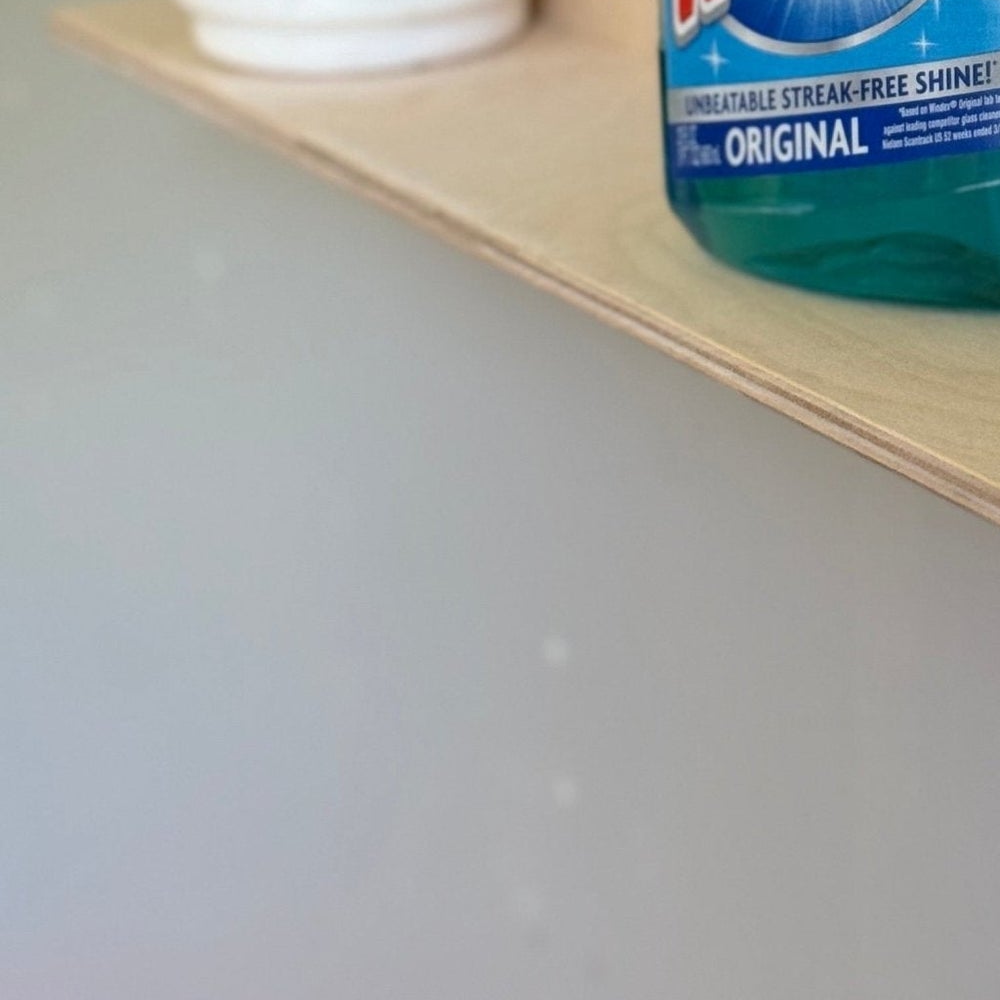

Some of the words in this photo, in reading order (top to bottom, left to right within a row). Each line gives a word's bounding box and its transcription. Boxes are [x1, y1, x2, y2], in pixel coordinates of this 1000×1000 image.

[684, 86, 776, 116] UNBEATABLE
[782, 74, 908, 110] STREAK-FREE
[920, 105, 928, 115] on
[959, 96, 982, 110] Original
[984, 95, 993, 105] lab
[883, 123, 904, 136] against
[905, 120, 927, 132] leading
[928, 116, 960, 130] competitor
[961, 113, 978, 126] glass
[943, 131, 952, 142] 52
[952, 129, 972, 140] weeks
[973, 125, 993, 137] ended
[725, 117, 869, 166] ORIGINAL
